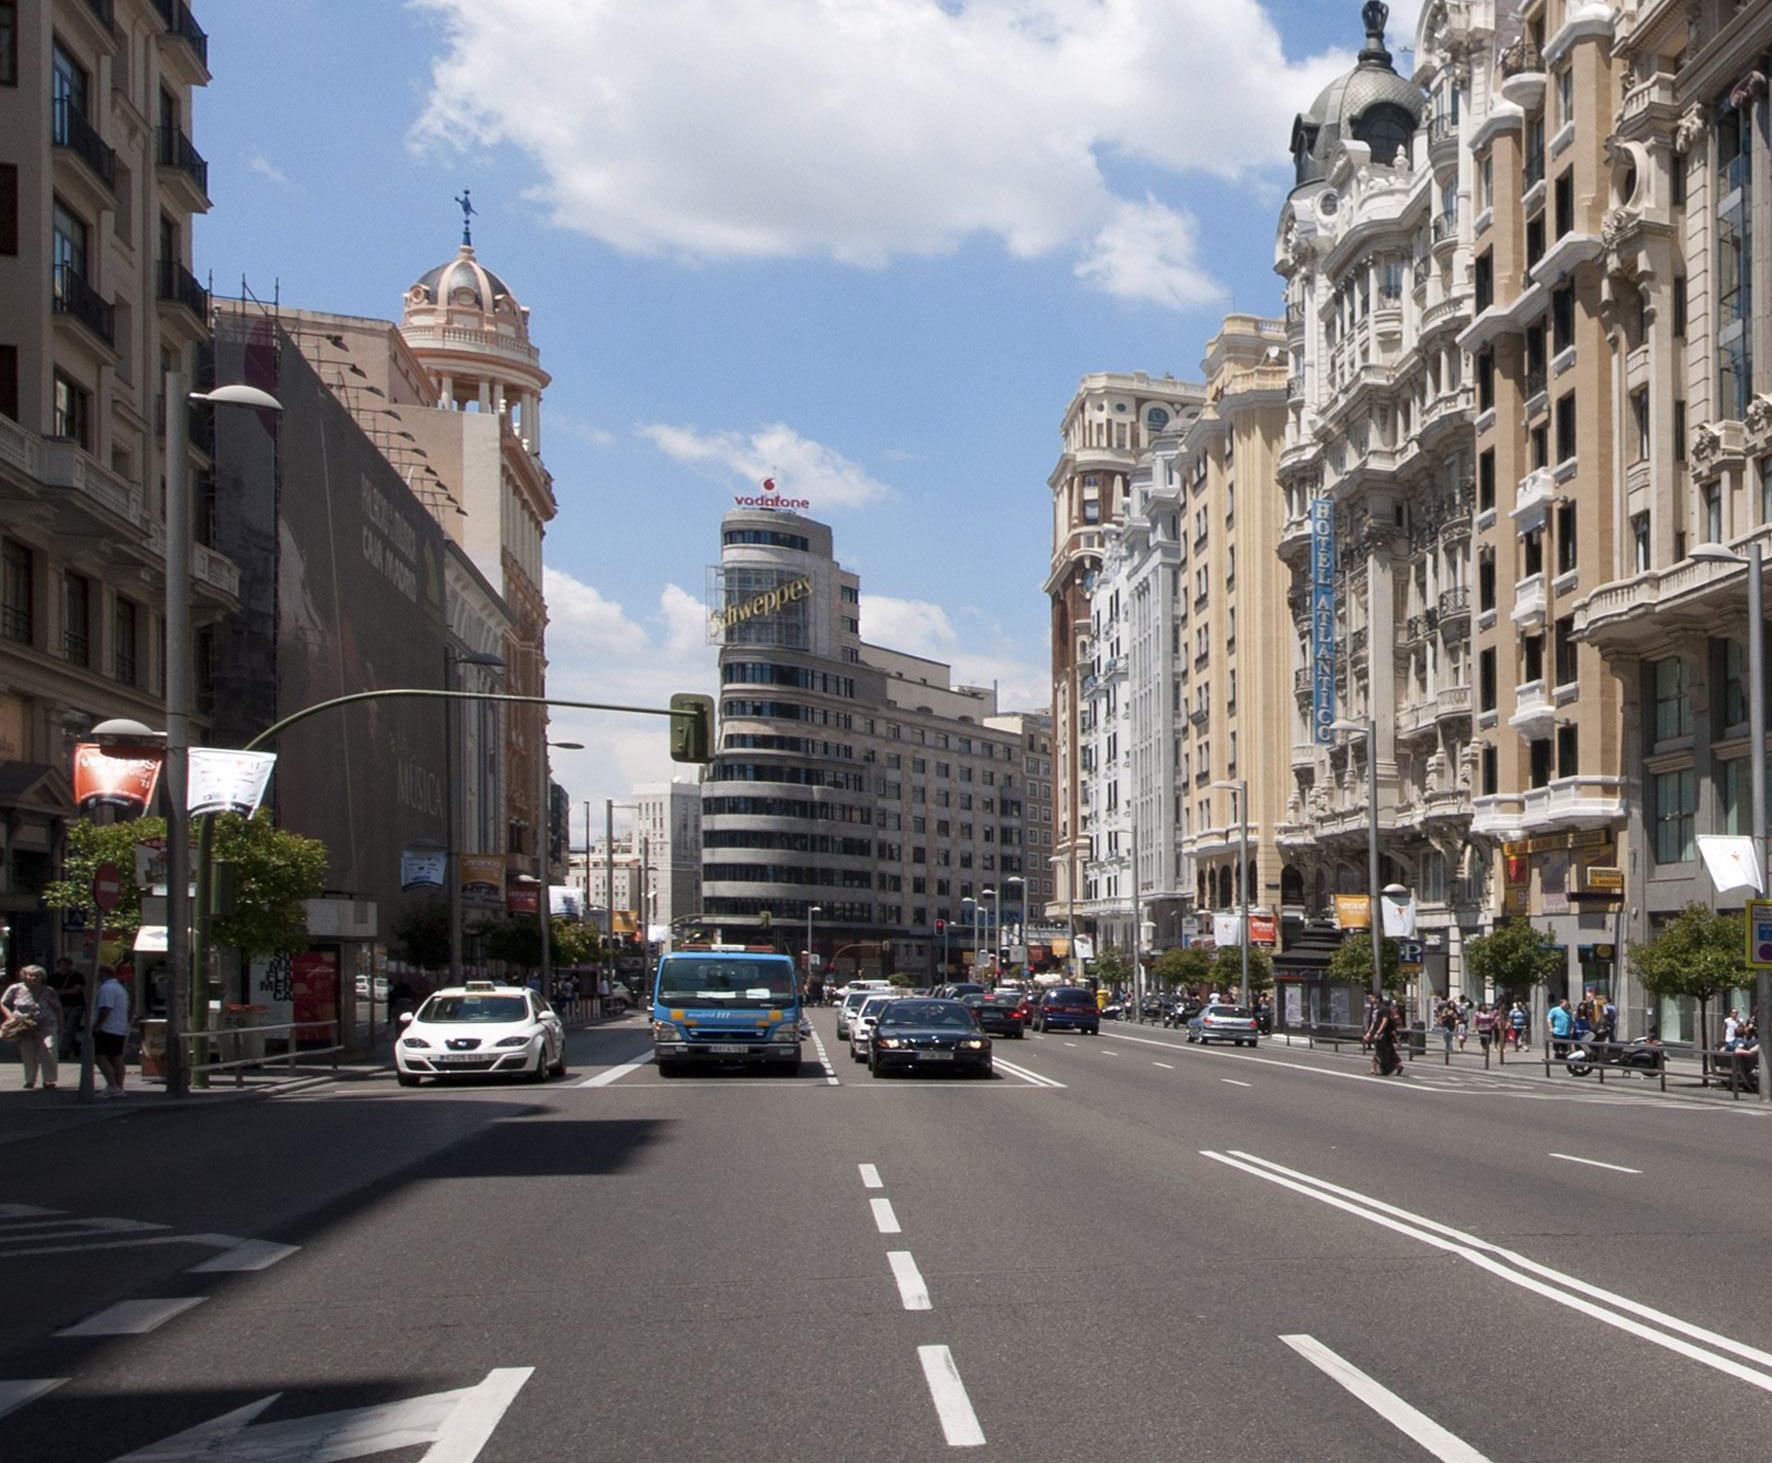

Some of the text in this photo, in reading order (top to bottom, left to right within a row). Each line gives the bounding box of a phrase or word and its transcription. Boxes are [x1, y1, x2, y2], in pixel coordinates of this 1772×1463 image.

[735, 493, 810, 509] vodafone
[1315, 503, 1331, 585] HOTEL
[709, 574, 814, 637] Schweppes
[273, 990, 294, 1002] CA
